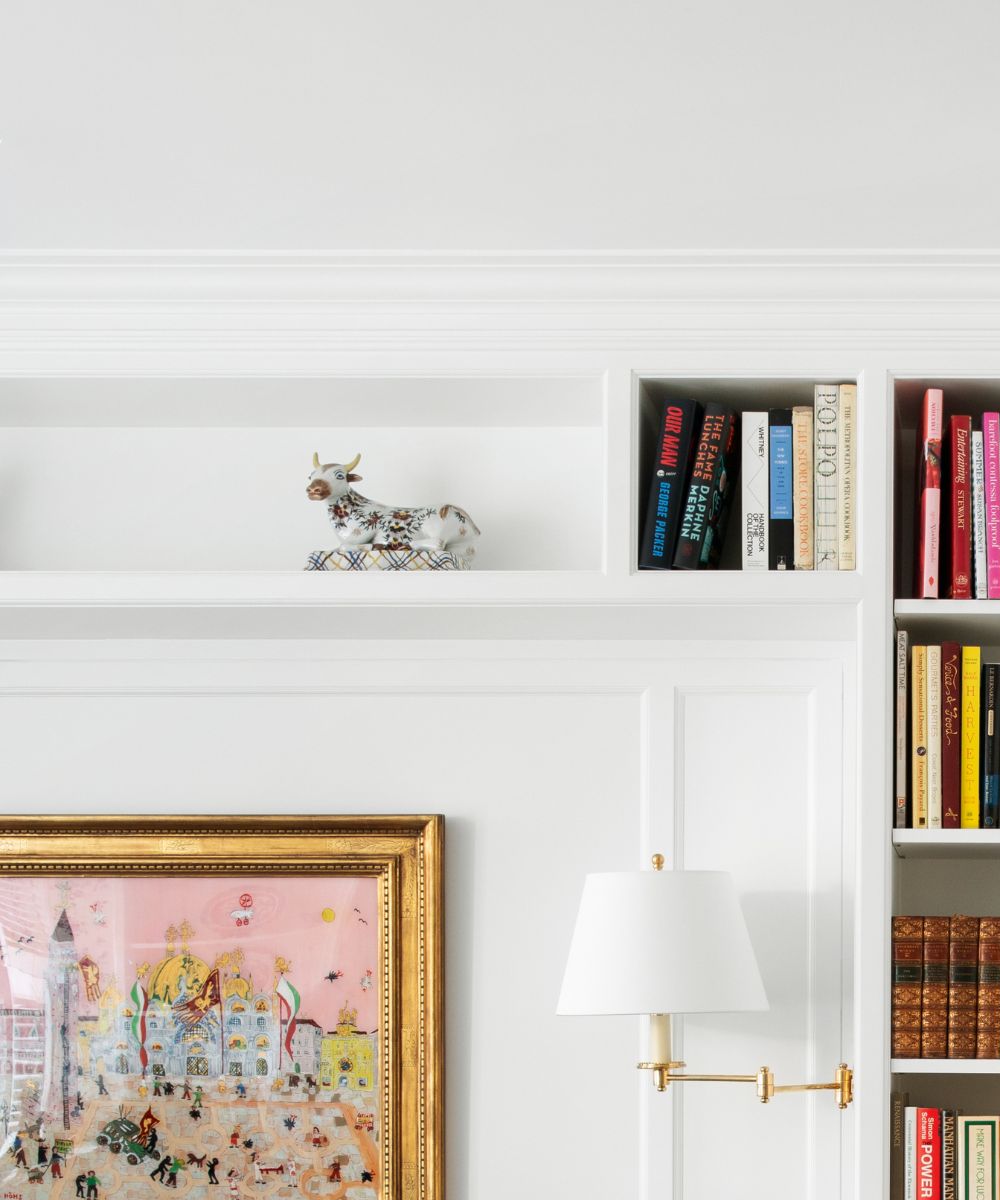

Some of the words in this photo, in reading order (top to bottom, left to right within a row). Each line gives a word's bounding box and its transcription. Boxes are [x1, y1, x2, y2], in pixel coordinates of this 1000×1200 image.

[665, 406, 683, 433] OUR
[711, 415, 725, 441] THE
[797, 423, 808, 445] THE
[817, 392, 837, 478] POLPO
[988, 419, 998, 459] barefoot
[660, 433, 680, 468] MAN
[693, 414, 712, 479] LUNCHES
[702, 444, 719, 481] FAME
[957, 428, 968, 484] Entertaining
[799, 448, 809, 486] STORE
[989, 461, 999, 502] contessa
[656, 482, 671, 517] GEORGE
[681, 484, 699, 538] MERKIN
[690, 484, 710, 542] DAPHNE
[753, 513, 758, 523] OF
[957, 490, 965, 529] STEWART
[652, 520, 668, 558] PACKER
[800, 490, 811, 558] COOKBOOK
[988, 505, 1000, 549] foolproof
[944, 654, 958, 696] Venice
[945, 707, 958, 746] Food
[965, 685, 976, 792] HARVEST
[945, 1116, 955, 1174] MANHATTAN
[976, 1128, 984, 1147] MAKE
[921, 1145, 933, 1198] POWER
[976, 1150, 984, 1166] WAY
[976, 1168, 984, 1183] FOR
